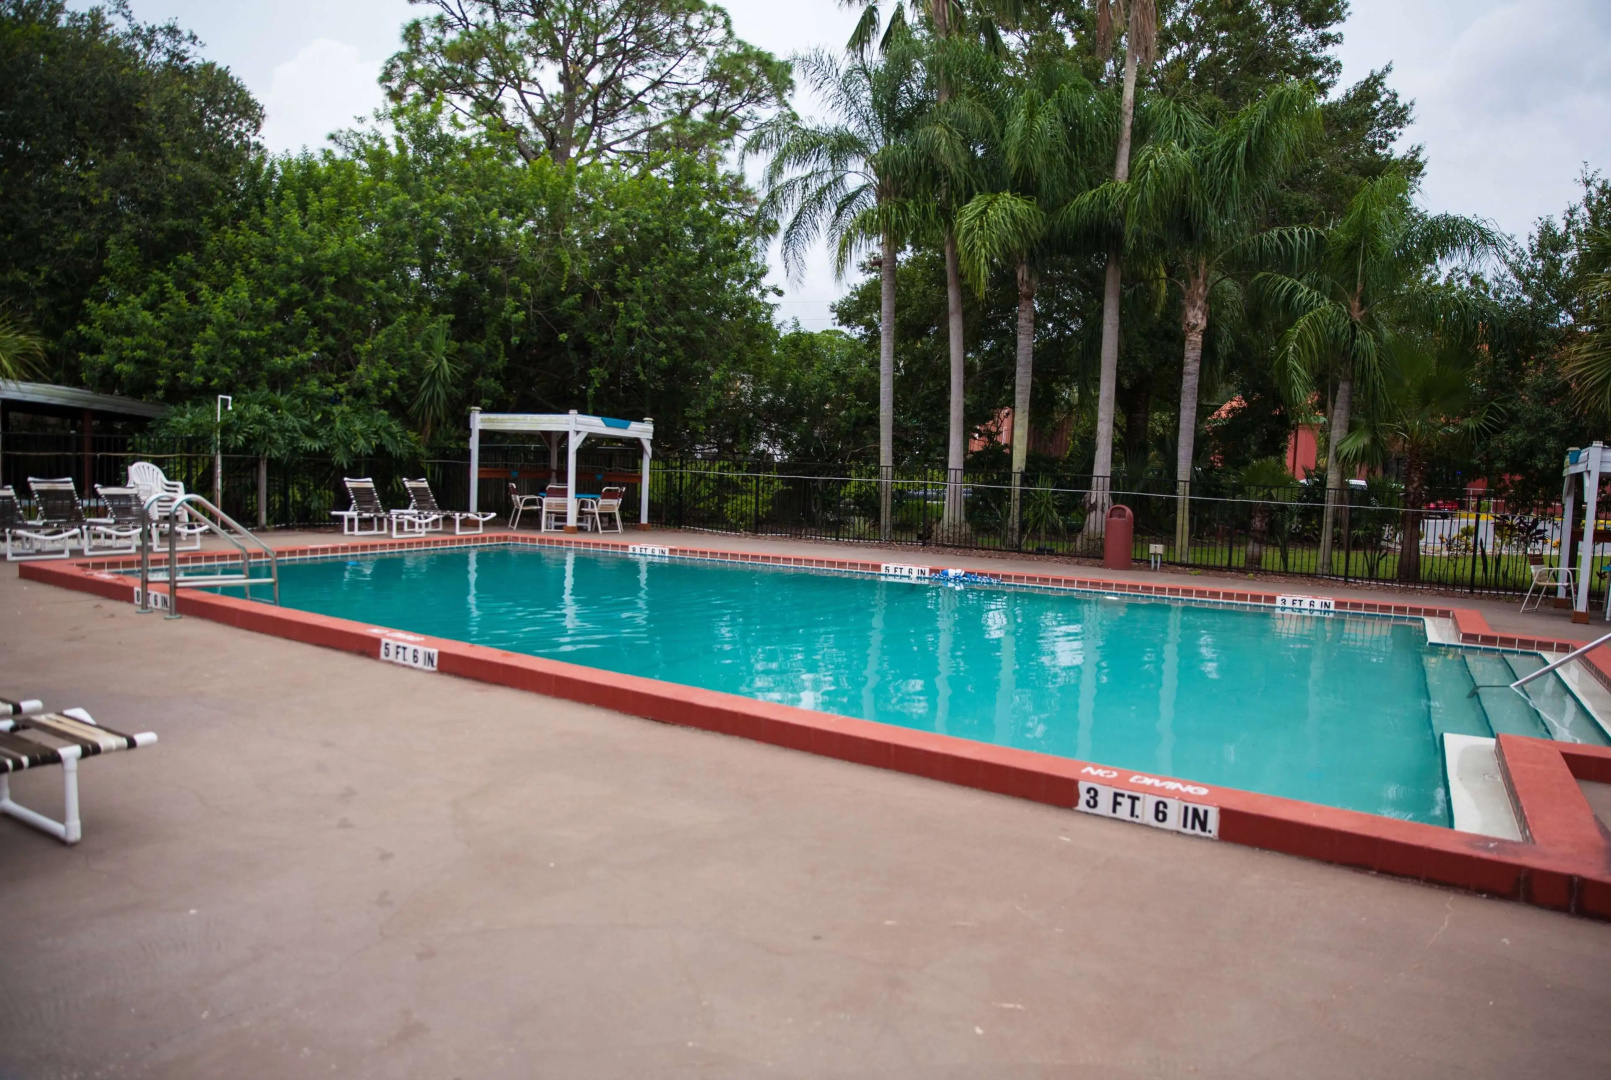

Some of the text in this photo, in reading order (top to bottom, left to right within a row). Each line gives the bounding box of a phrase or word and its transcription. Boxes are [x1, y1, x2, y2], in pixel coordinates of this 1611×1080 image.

[1291, 599, 1304, 607] FT
[1320, 601, 1331, 609] IN
[384, 642, 390, 658] 5
[412, 648, 419, 664] 6
[1081, 766, 1209, 796] NO DIVING
[1085, 786, 1212, 834] 3 FT. 6 IN.
